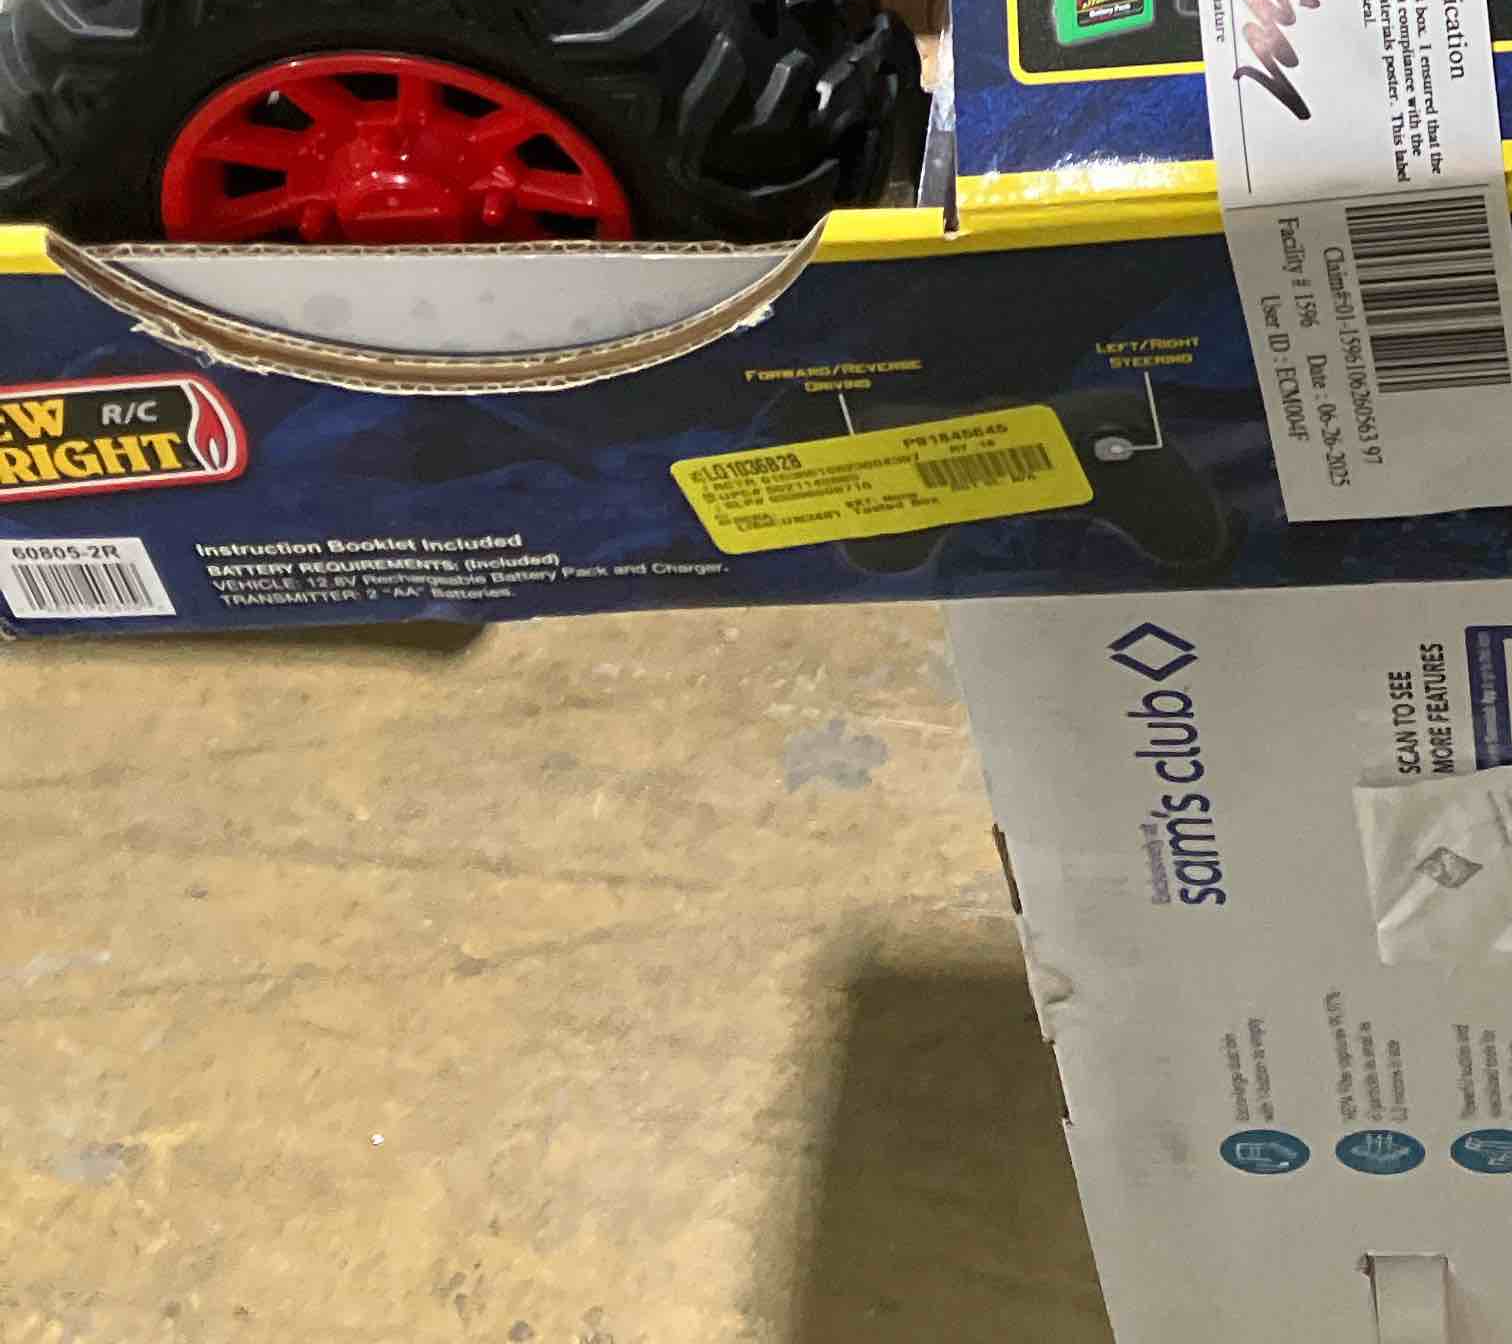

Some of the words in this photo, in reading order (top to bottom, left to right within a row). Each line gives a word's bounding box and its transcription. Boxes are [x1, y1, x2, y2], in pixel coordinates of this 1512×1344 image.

[1398, 7, 1415, 92] compliance
[1382, 55, 1399, 107] poster.
[1420, 56, 1438, 115] ensured
[1392, 112, 1405, 146] This
[1408, 96, 1421, 130] with
[1411, 133, 1423, 156] the
[1427, 119, 1440, 148] that
[1395, 149, 1411, 183] label
[1430, 152, 1444, 174] the
[1278, 216, 1305, 275] Facility
[1261, 294, 1281, 329] User
[1294, 294, 1320, 328] 1596
[1094, 335, 1201, 355] LEFT/RIGHT
[1269, 333, 1290, 353] ID
[1109, 352, 1195, 370] STEERING
[1306, 353, 1328, 389] Date
[101, 399, 159, 426] R/C
[1316, 403, 1351, 487] 06-26-2025
[11, 544, 122, 562] 60805-2R
[195, 541, 322, 558] Instruction
[326, 538, 417, 555] Booklet
[421, 533, 523, 553] Included
[206, 562, 295, 578] BATTERY
[464, 551, 561, 571] (Included)
[490, 568, 557, 585] Battery
[560, 565, 609, 580] Pack
[612, 563, 647, 576] and
[651, 561, 730, 576] Charger.
[1388, 670, 1414, 701] SEE
[1420, 643, 1450, 723] FEATURES
[1392, 703, 1417, 727] TO
[1126, 688, 1205, 784] club
[1396, 731, 1422, 775] SCAN
[1429, 726, 1455, 775] MORE
[1149, 793, 1227, 905] sam's
